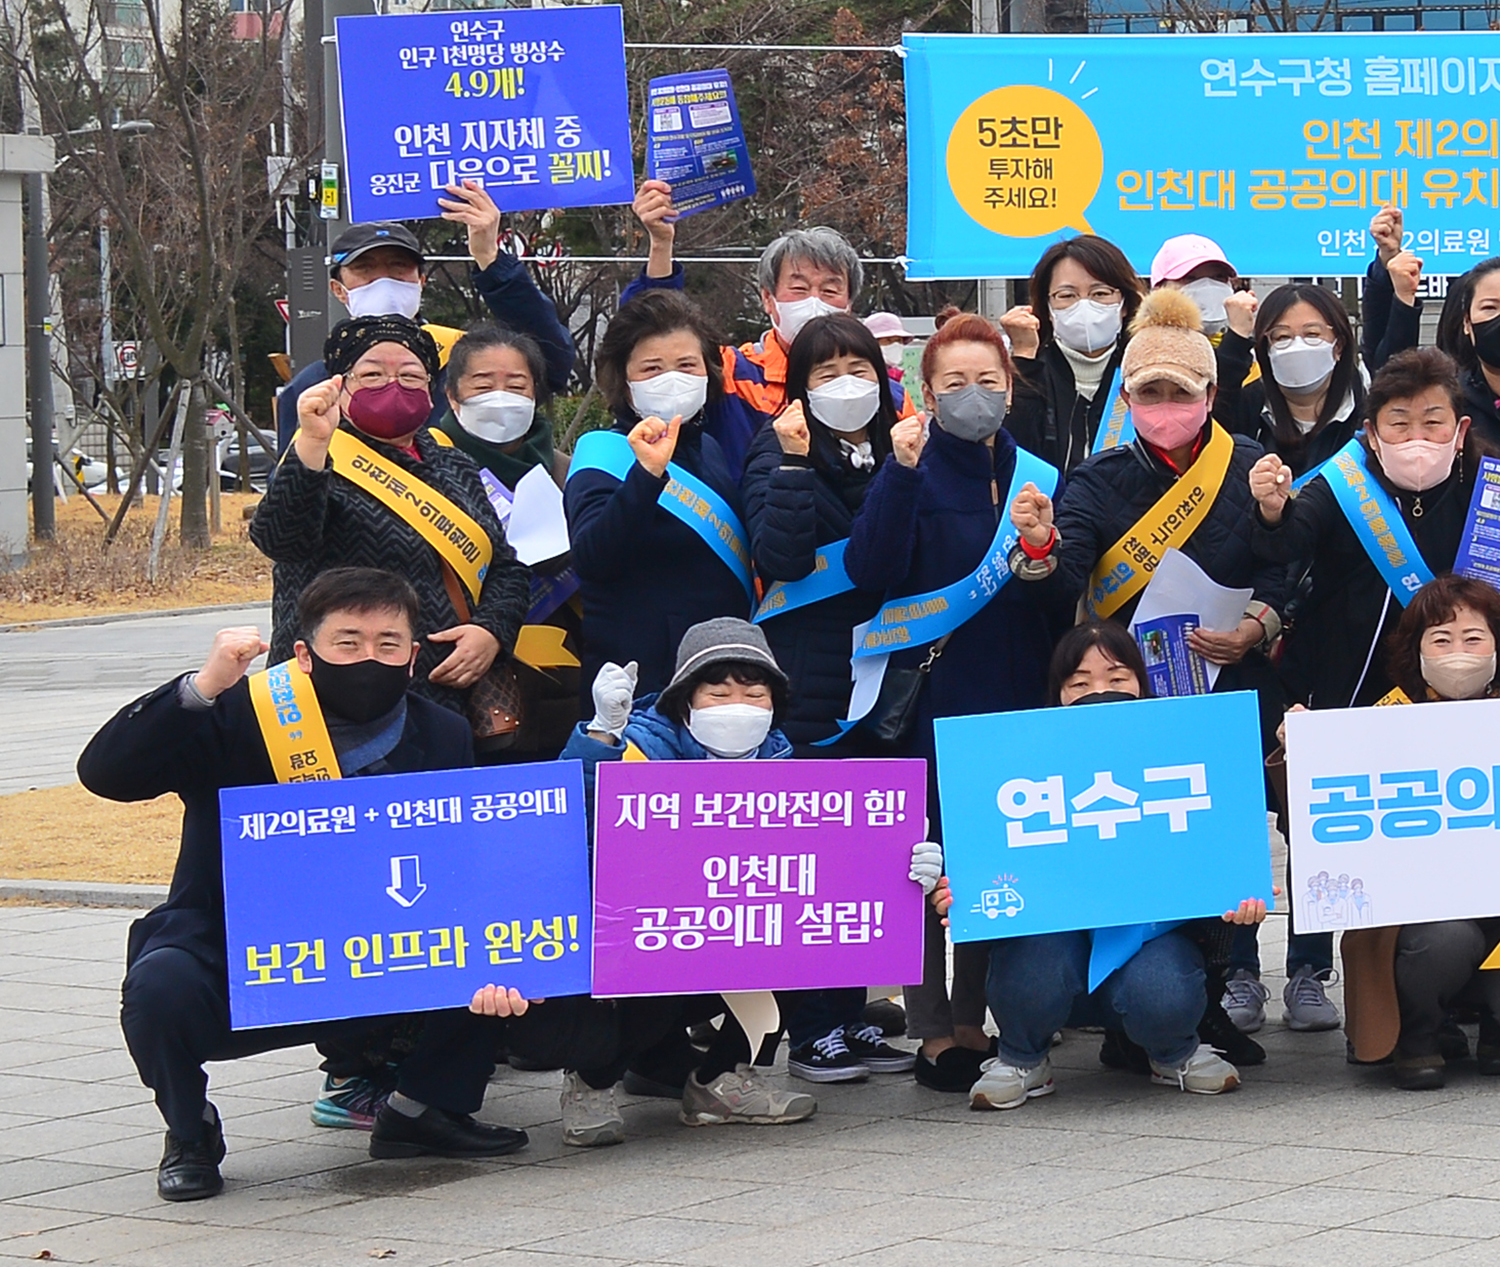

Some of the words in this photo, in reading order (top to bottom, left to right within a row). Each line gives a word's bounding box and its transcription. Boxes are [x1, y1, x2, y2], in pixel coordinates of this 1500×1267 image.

[451, 20, 505, 41] 연수구
[399, 47, 437, 69] 인구
[442, 43, 504, 67] 1천명당
[510, 40, 565, 63] 병상수
[444, 69, 525, 100] 4.9개!
[1201, 57, 1352, 98] 연수구청
[394, 123, 451, 159] 인천
[459, 118, 545, 152] 지자체
[554, 116, 582, 148] 중
[977, 116, 1062, 150] 5초만
[1303, 118, 1380, 160] 인천
[370, 173, 421, 196] 옹진군
[429, 158, 540, 193] 다음으로
[547, 150, 611, 184] 꼴찌!
[988, 158, 1053, 180] 투자해
[983, 185, 1057, 209] 주세요!
[1115, 169, 1236, 212] 인천대
[1247, 168, 1408, 212] 공공의대
[1317, 228, 1366, 257] 인천
[1152, 486, 1205, 547] 인천인구
[1122, 536, 1160, 575] 천명당
[239, 806, 356, 841] 제2의료원
[388, 800, 462, 830] 인천대
[470, 788, 567, 820] 공공의대
[614, 793, 680, 830] 지역
[692, 792, 853, 827] 보건안전의
[862, 790, 907, 826] 힘!
[997, 763, 1211, 849] 연수구
[703, 855, 815, 898] 인천대
[632, 907, 783, 953] 공공의대
[796, 902, 885, 946] 설립!
[245, 931, 327, 987] 보건
[343, 927, 470, 979] 인프라
[484, 915, 579, 965] 완성!
